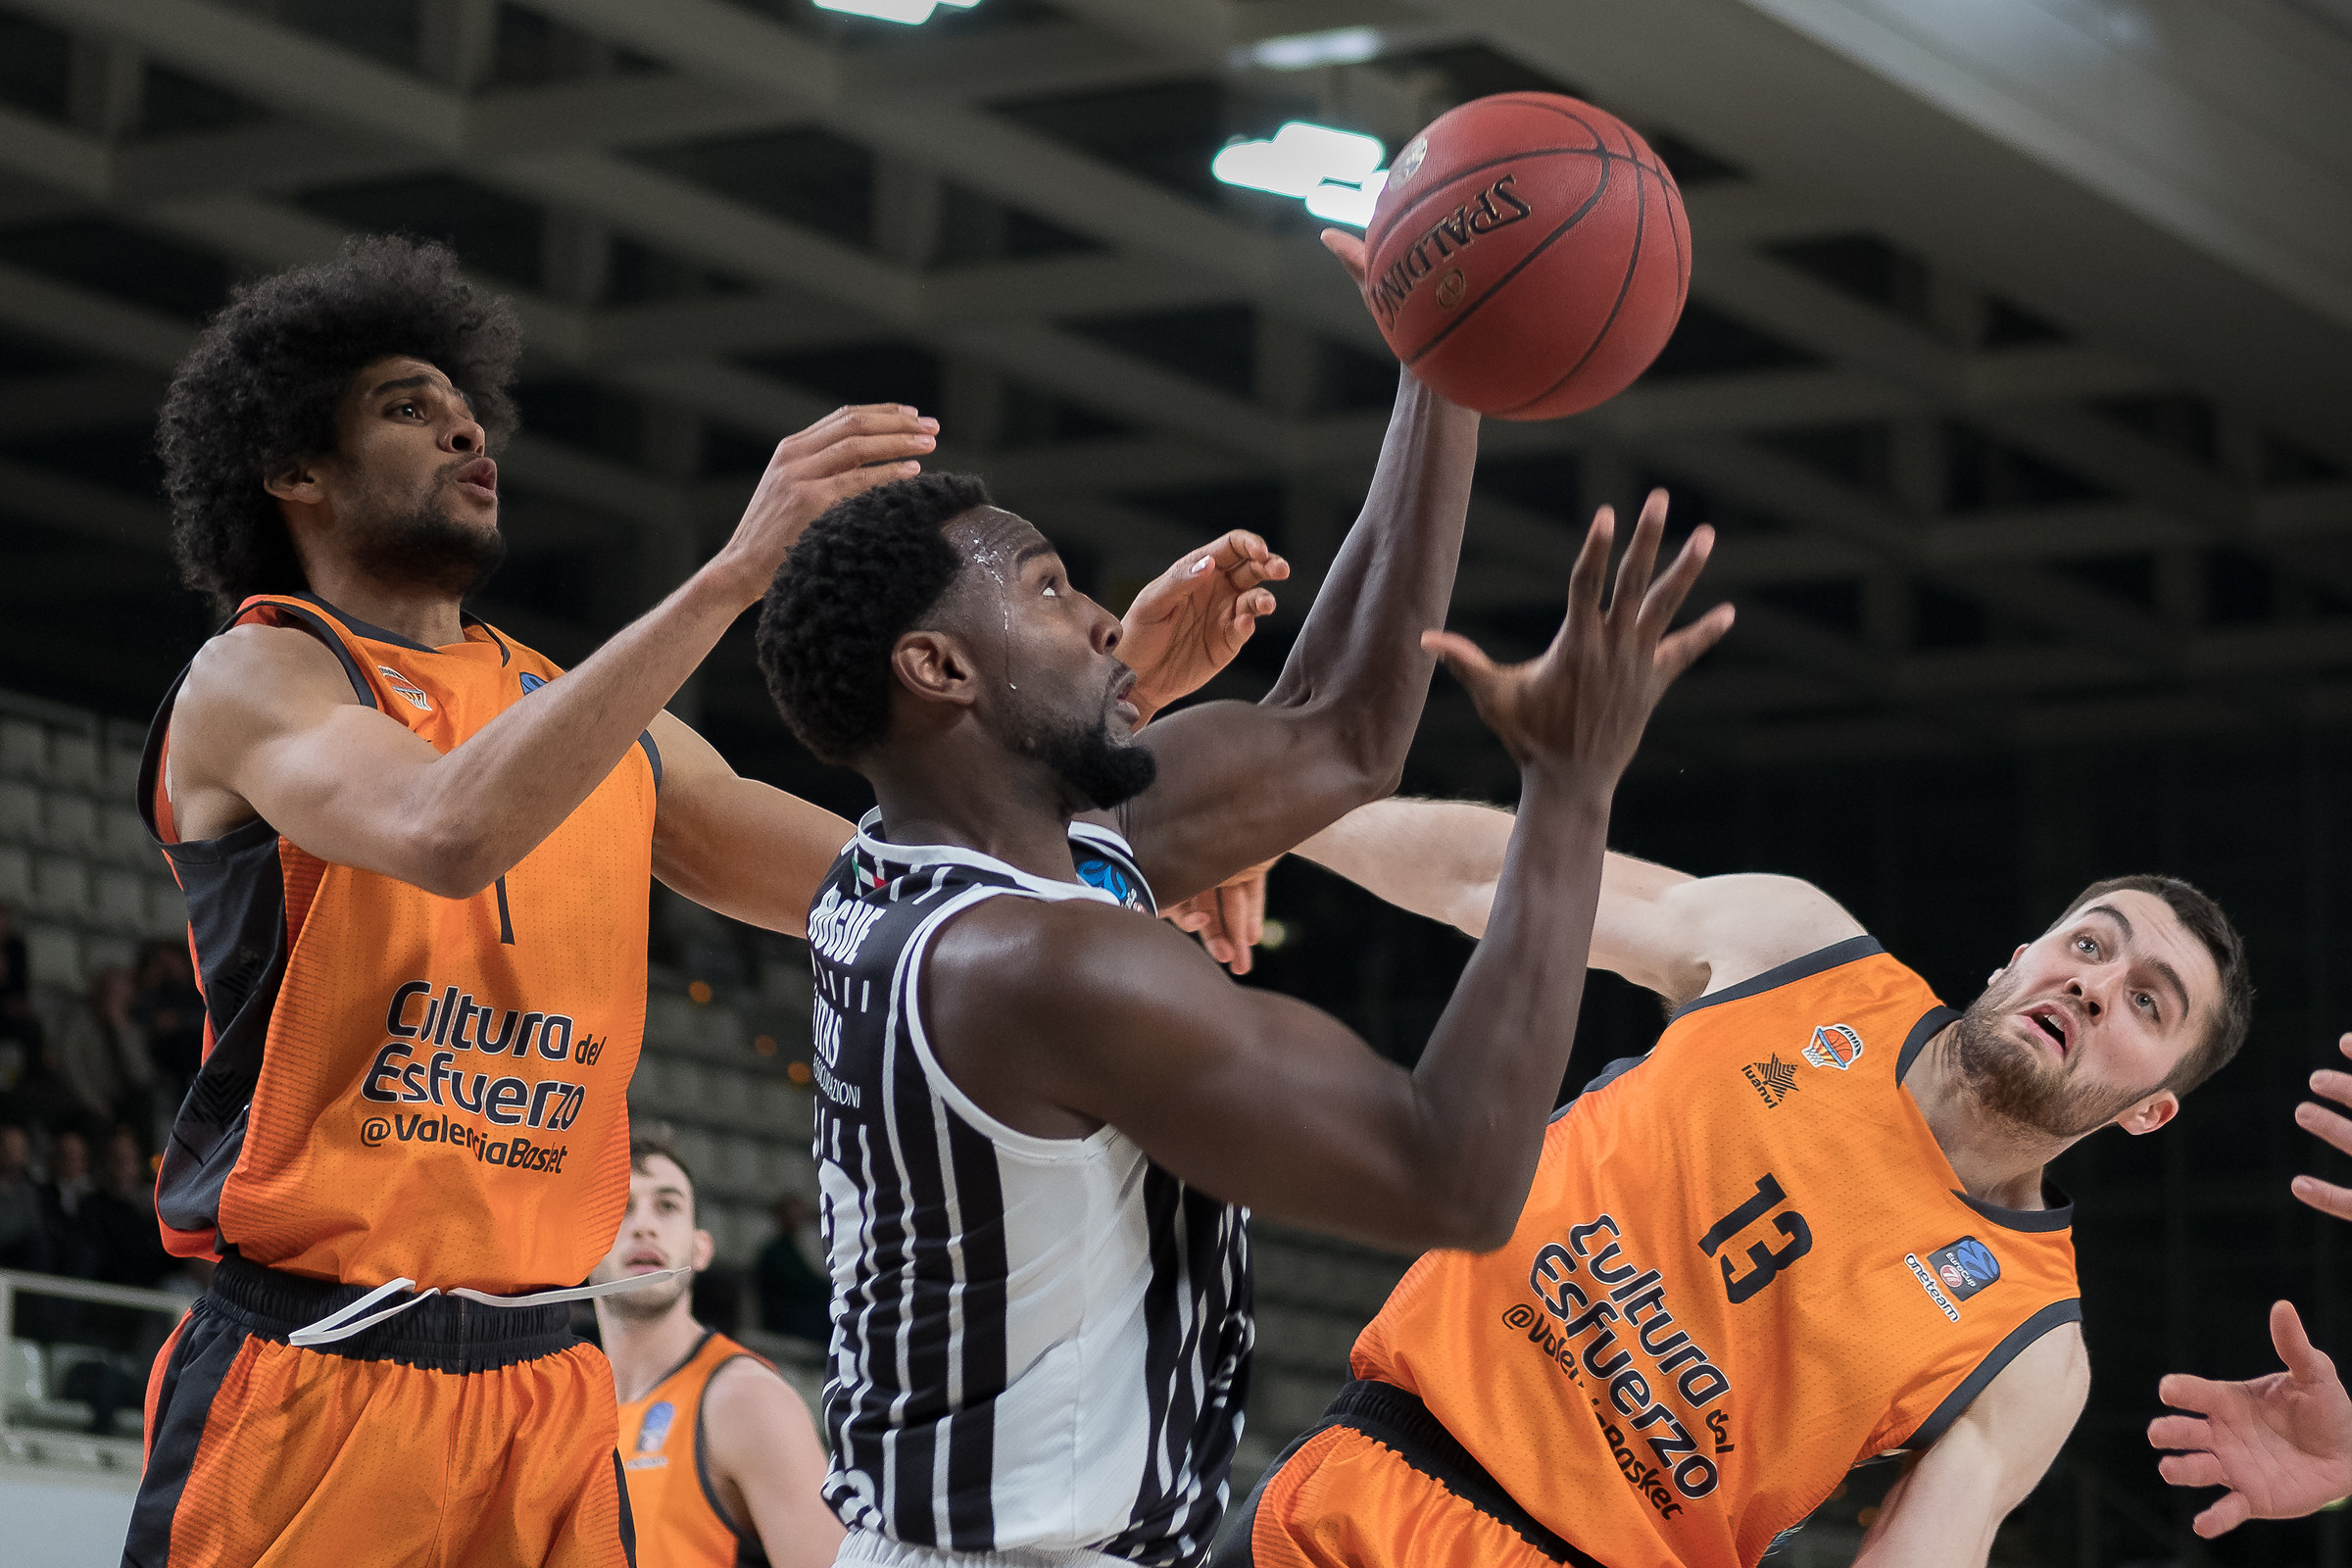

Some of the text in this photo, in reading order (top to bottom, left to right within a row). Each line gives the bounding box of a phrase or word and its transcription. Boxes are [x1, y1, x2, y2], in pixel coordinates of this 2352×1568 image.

[1371, 173, 1532, 330] SPALDING
[361, 1042, 586, 1131] Esfuerzo
[575, 1034, 607, 1065] del
[1697, 1172, 1813, 1304] 13
[1904, 1253, 1960, 1323] oneteam
[1529, 1243, 1718, 1499] Esfuerzo
[1568, 1213, 1731, 1409] Cultura
